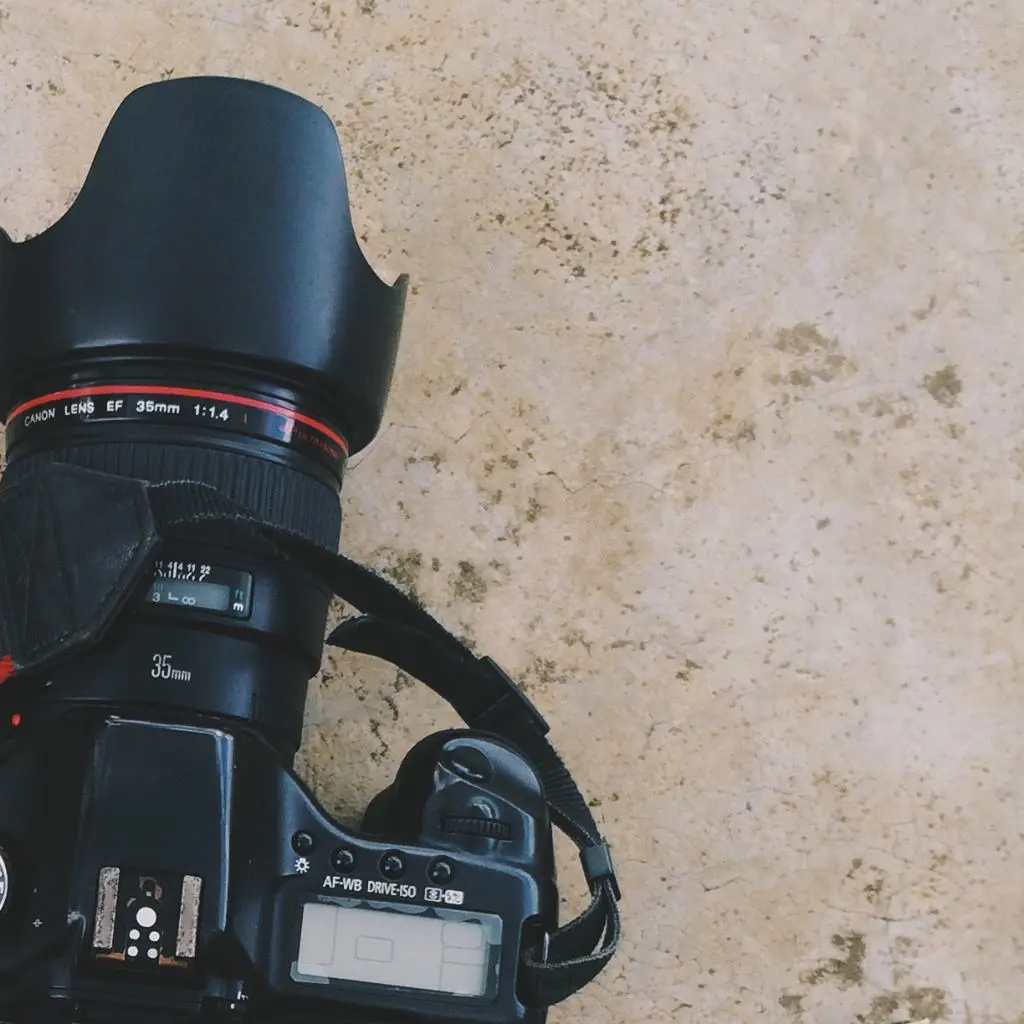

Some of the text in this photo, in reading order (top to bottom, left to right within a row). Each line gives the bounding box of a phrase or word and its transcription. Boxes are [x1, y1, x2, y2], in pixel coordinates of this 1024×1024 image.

[24, 400, 229, 428] CANON LENS EF 35mm 1:1.4
[187, 563, 196, 573] 11
[200, 565, 211, 575] 22
[152, 592, 244, 612] 3 m
[151, 653, 191, 681] 35mm
